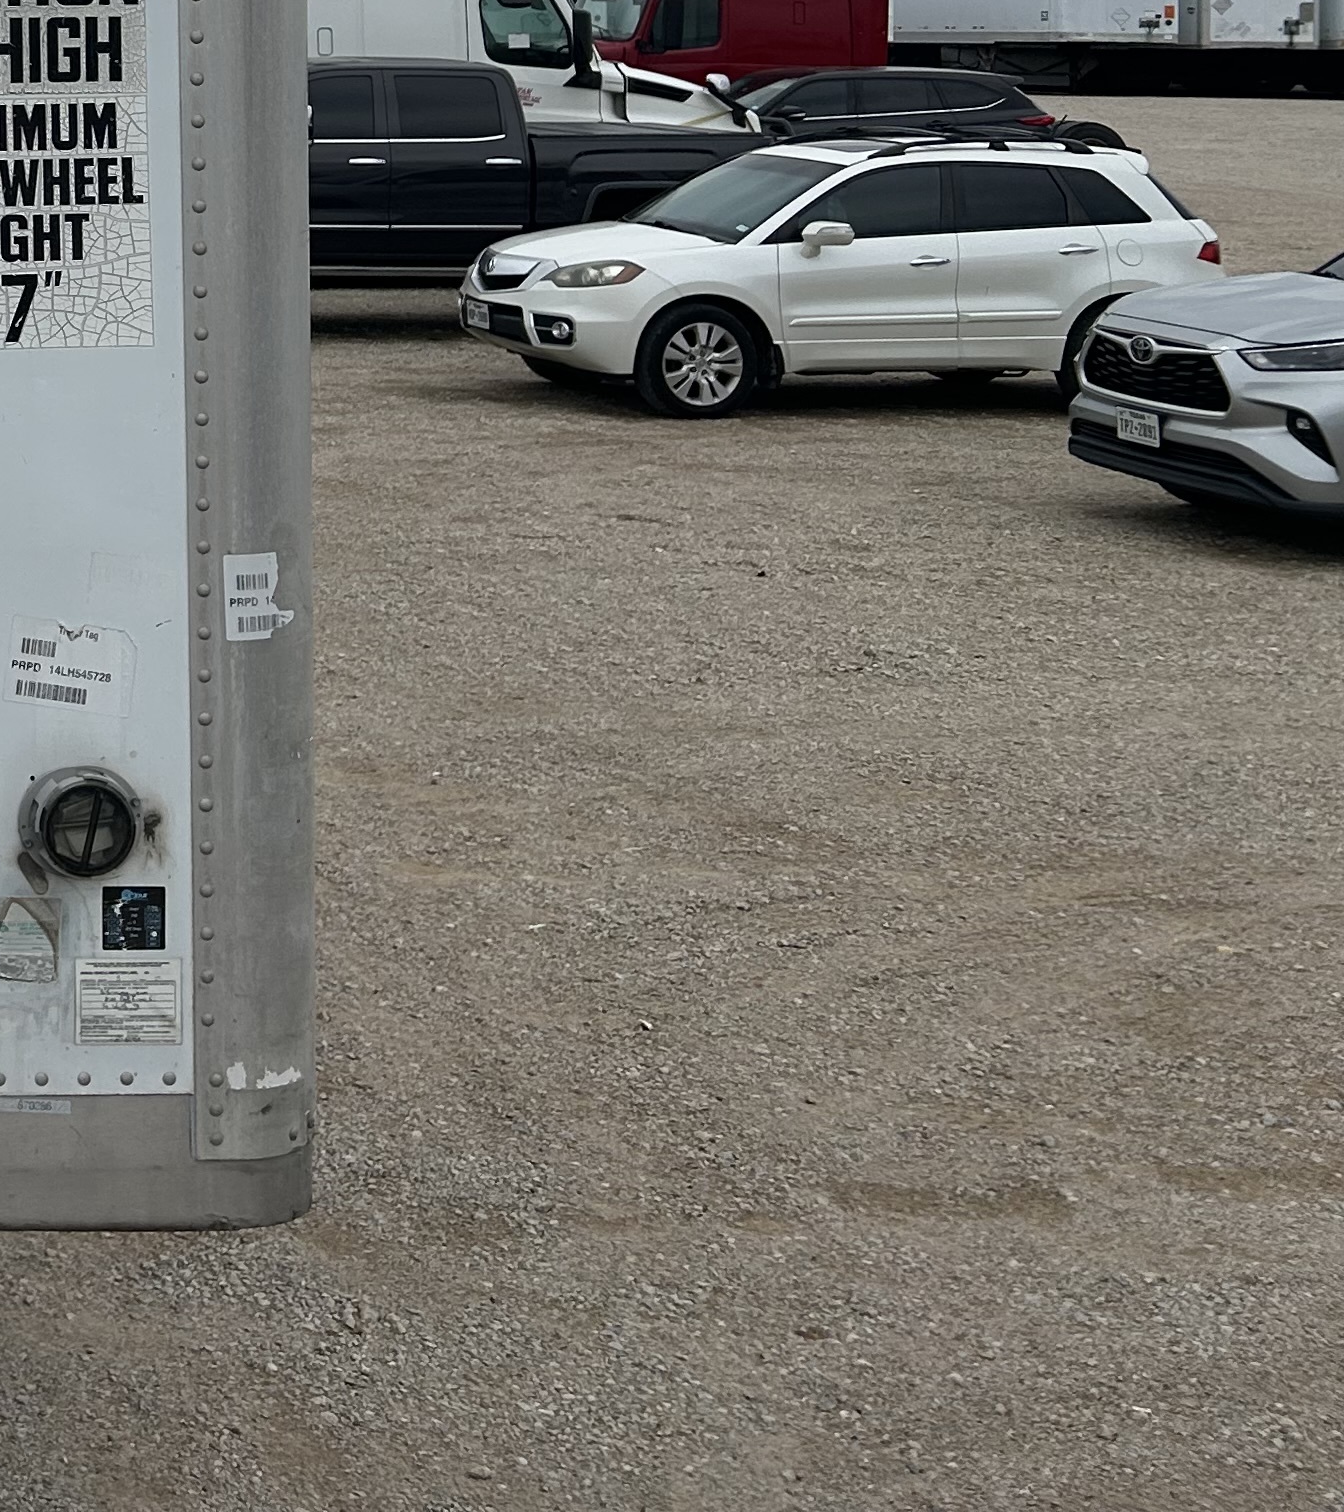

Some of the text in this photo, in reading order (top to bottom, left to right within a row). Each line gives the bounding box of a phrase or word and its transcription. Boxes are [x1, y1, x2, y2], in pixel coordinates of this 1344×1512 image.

[229, 596, 259, 607] PRPD
[85, 629, 99, 642] Tag
[12, 659, 112, 683] PRPD 14LH545728
